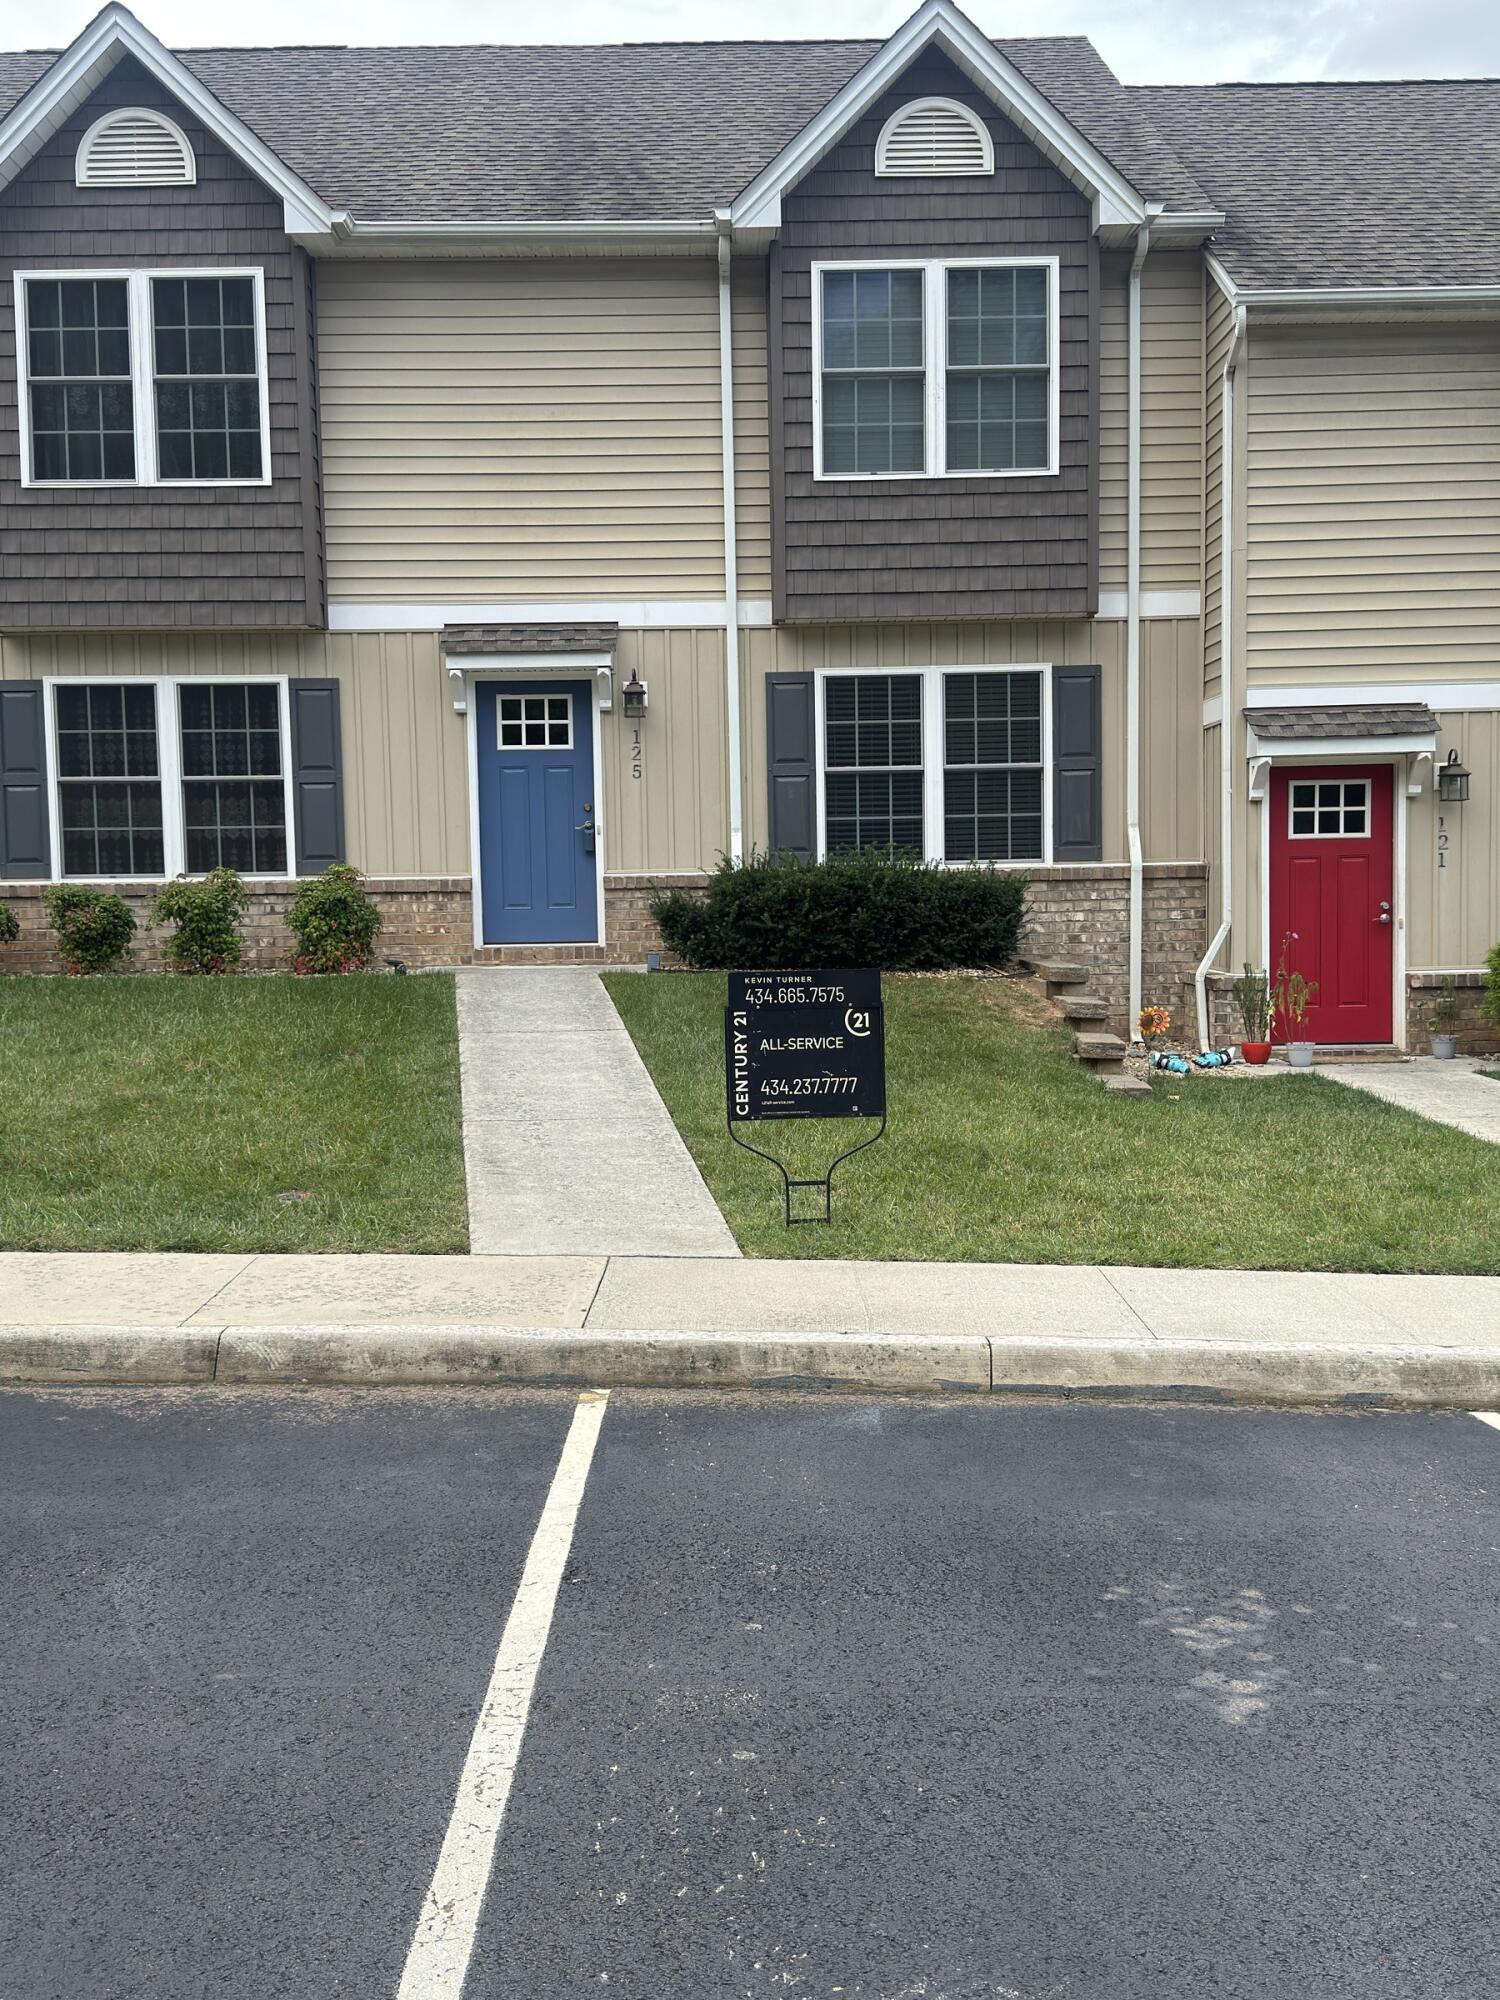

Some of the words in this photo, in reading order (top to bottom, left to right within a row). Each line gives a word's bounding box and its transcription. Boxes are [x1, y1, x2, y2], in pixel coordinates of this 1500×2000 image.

[632, 730, 642, 779] 125
[1438, 817, 1448, 867] 121
[776, 975, 812, 983] TURNER
[745, 987, 845, 1004] 434.665.7575
[733, 1011, 747, 1026] 21
[853, 1012, 870, 1028] 21
[760, 1037, 844, 1050] ALL-SERVICE
[734, 1030, 749, 1115] CENTURY
[760, 1077, 858, 1095] 434.237.7777
